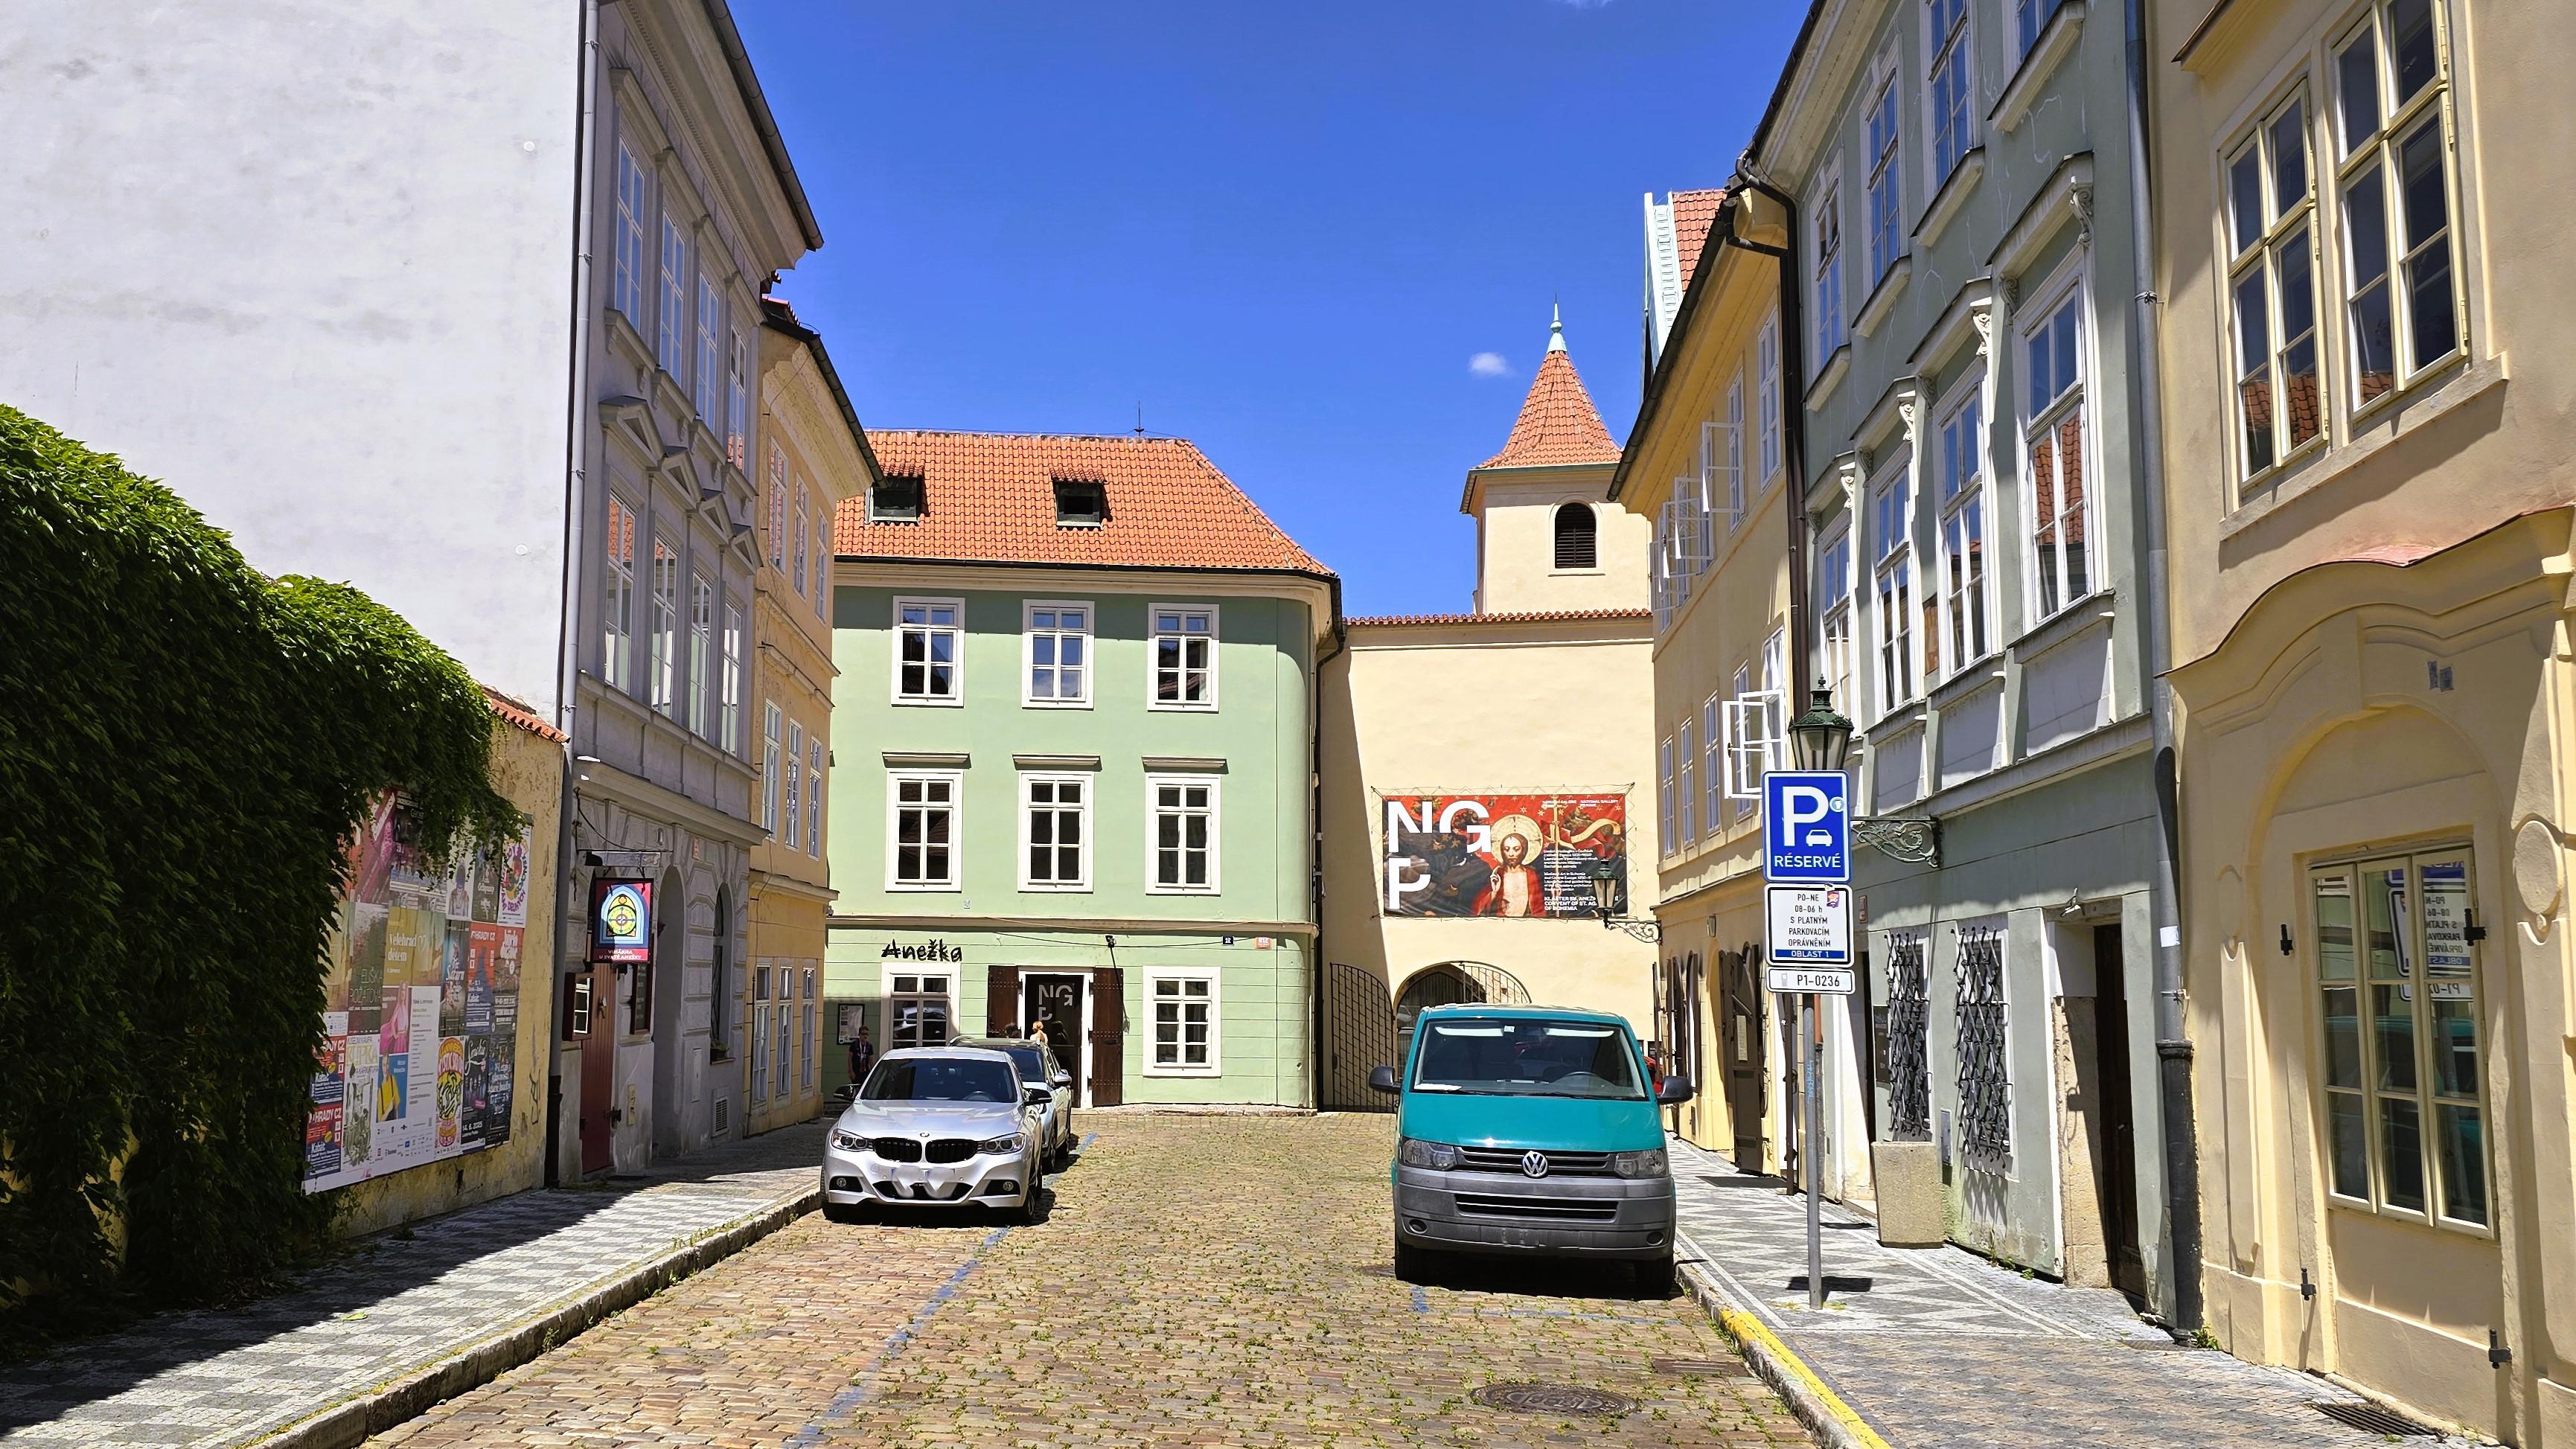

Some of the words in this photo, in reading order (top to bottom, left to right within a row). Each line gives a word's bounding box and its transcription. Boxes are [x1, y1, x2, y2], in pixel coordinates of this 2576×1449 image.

[1783, 787, 1829, 846] P
[1774, 852, 1841, 868] RÉSERVÉ
[1794, 905, 1815, 913] 08-06
[1797, 914, 1828, 924] PLATNÝM
[1789, 925, 1829, 936] PARKOVACÍM
[389, 933, 417, 947] Velehrad
[1788, 936, 1831, 947] OPRÁVNĚNÍM
[881, 938, 962, 962] Anežka
[1797, 975, 1841, 987] P1-0236
[334, 1107, 342, 1119] CZ
